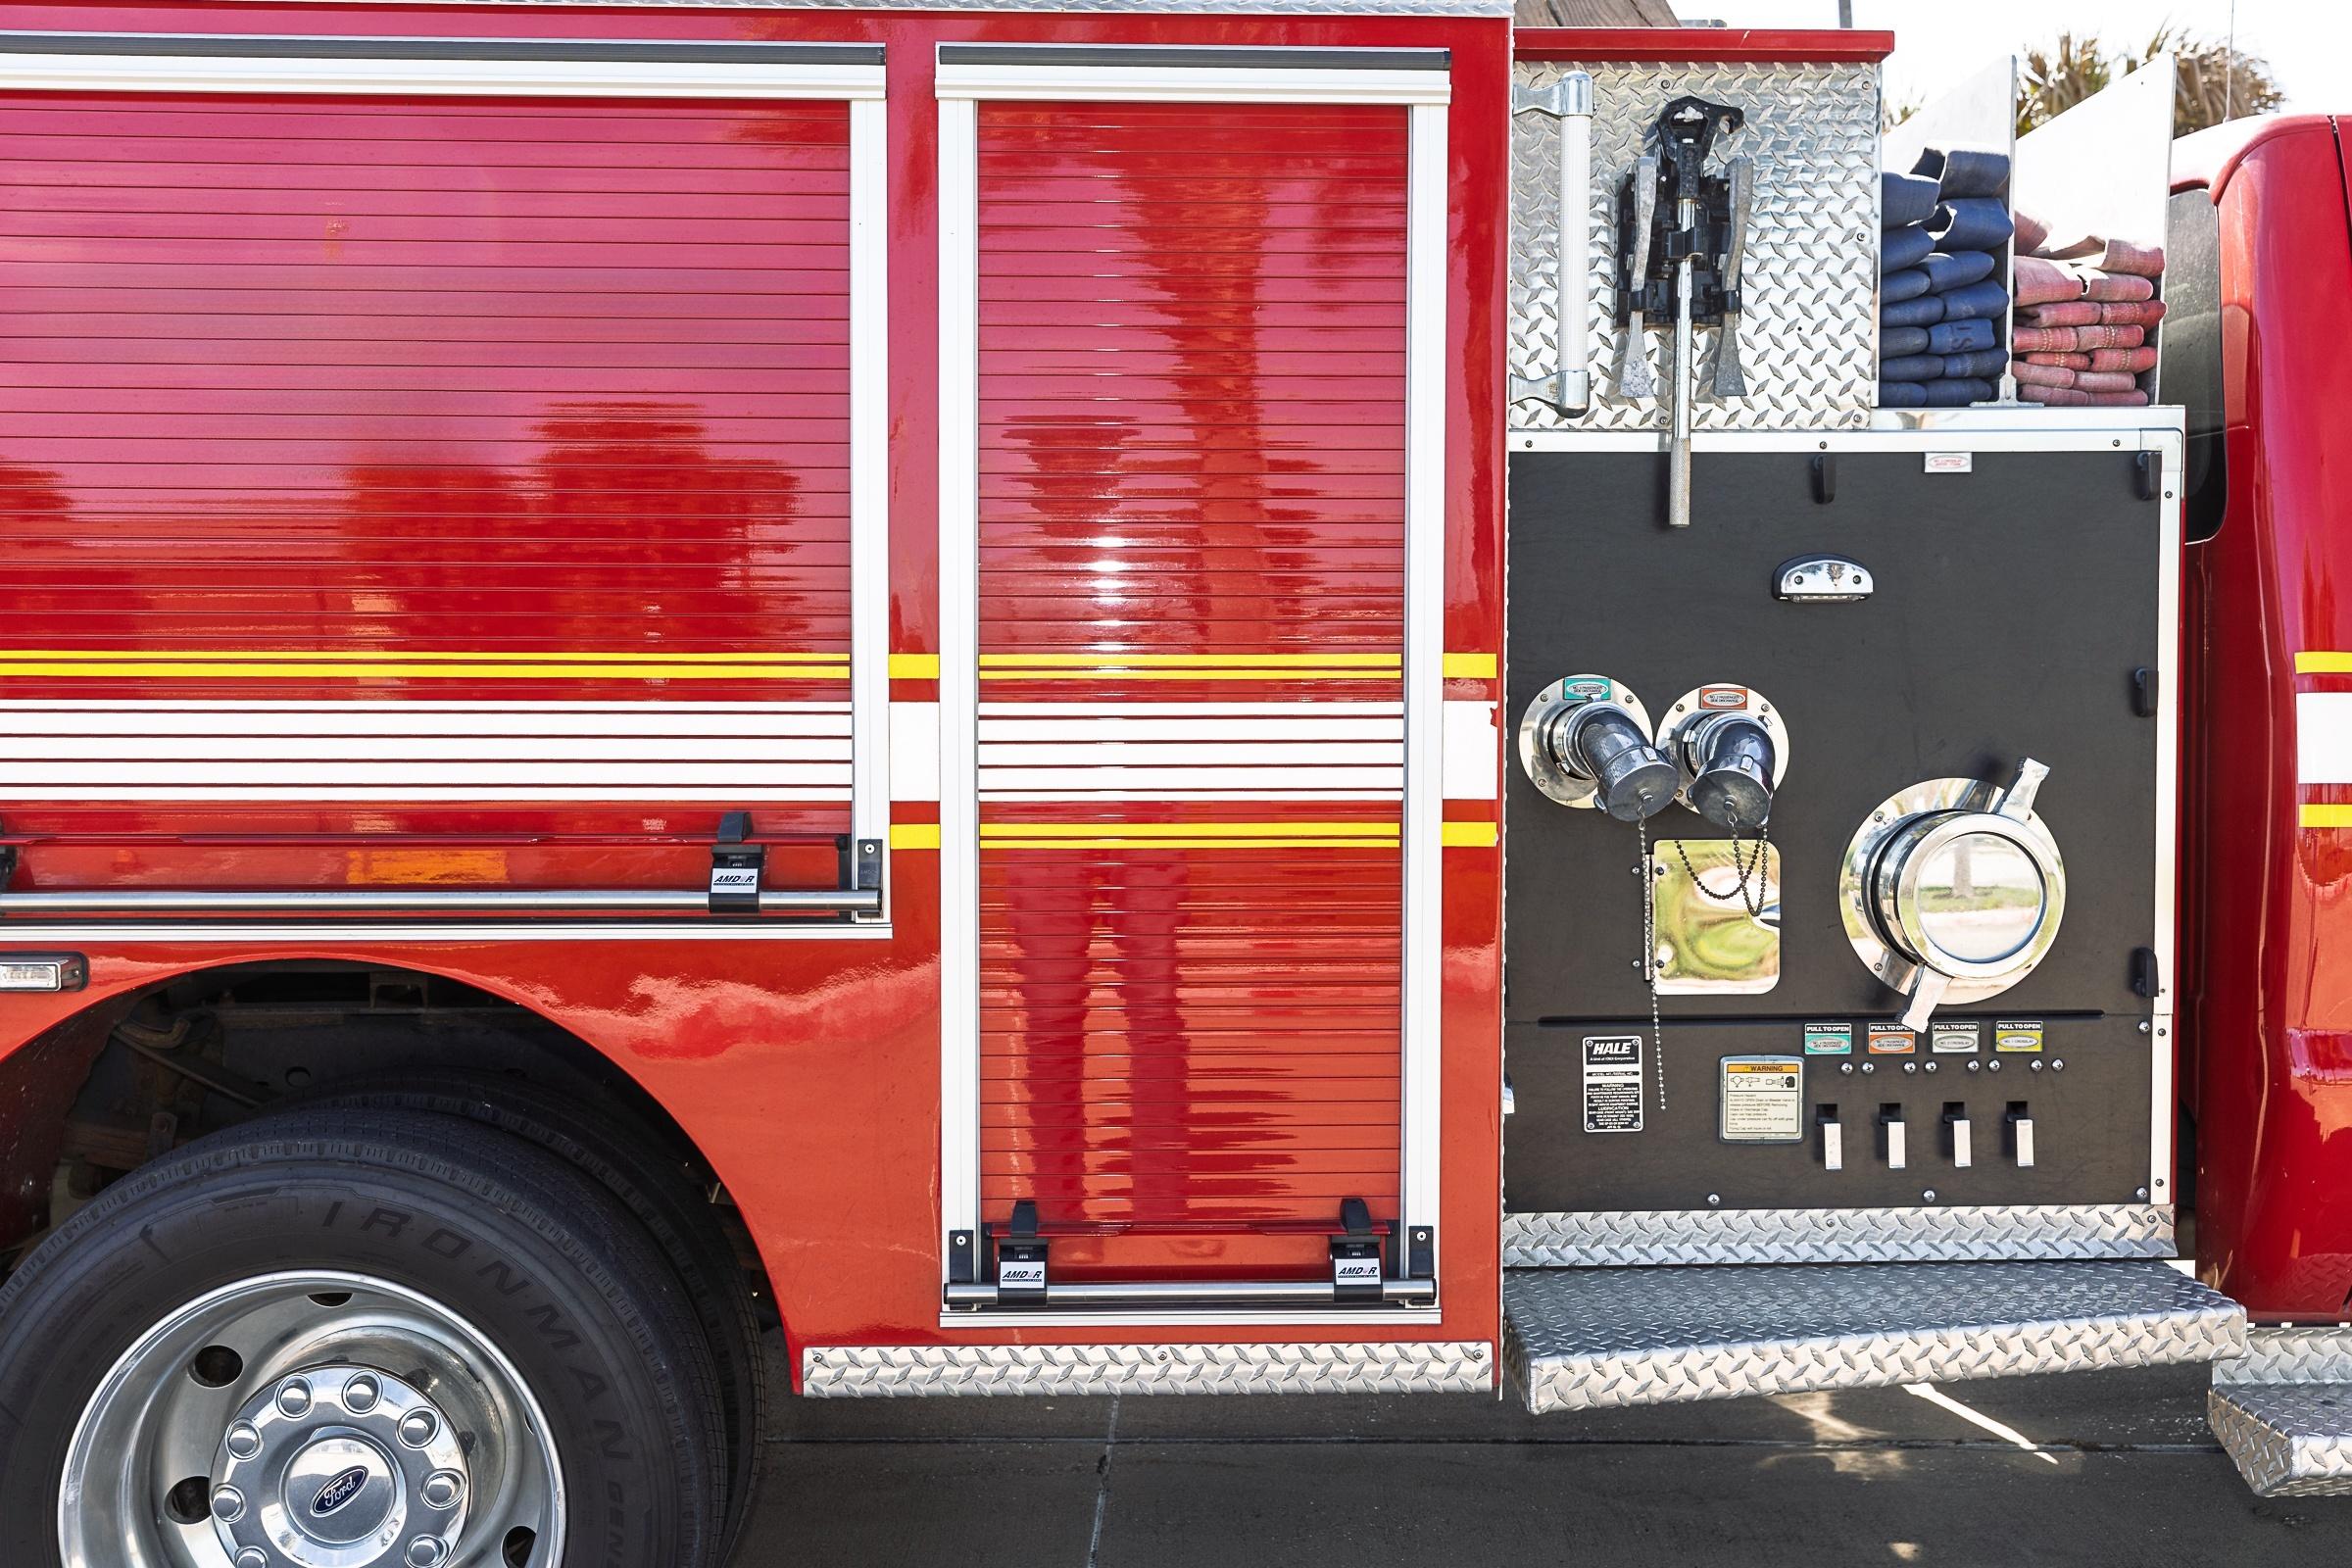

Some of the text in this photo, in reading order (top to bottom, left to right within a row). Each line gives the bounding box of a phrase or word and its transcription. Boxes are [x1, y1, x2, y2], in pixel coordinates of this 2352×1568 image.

[1593, 1042, 1632, 1055] HALE
[321, 1201, 633, 1460] IRONMAN
[324, 1476, 355, 1507] Ford
